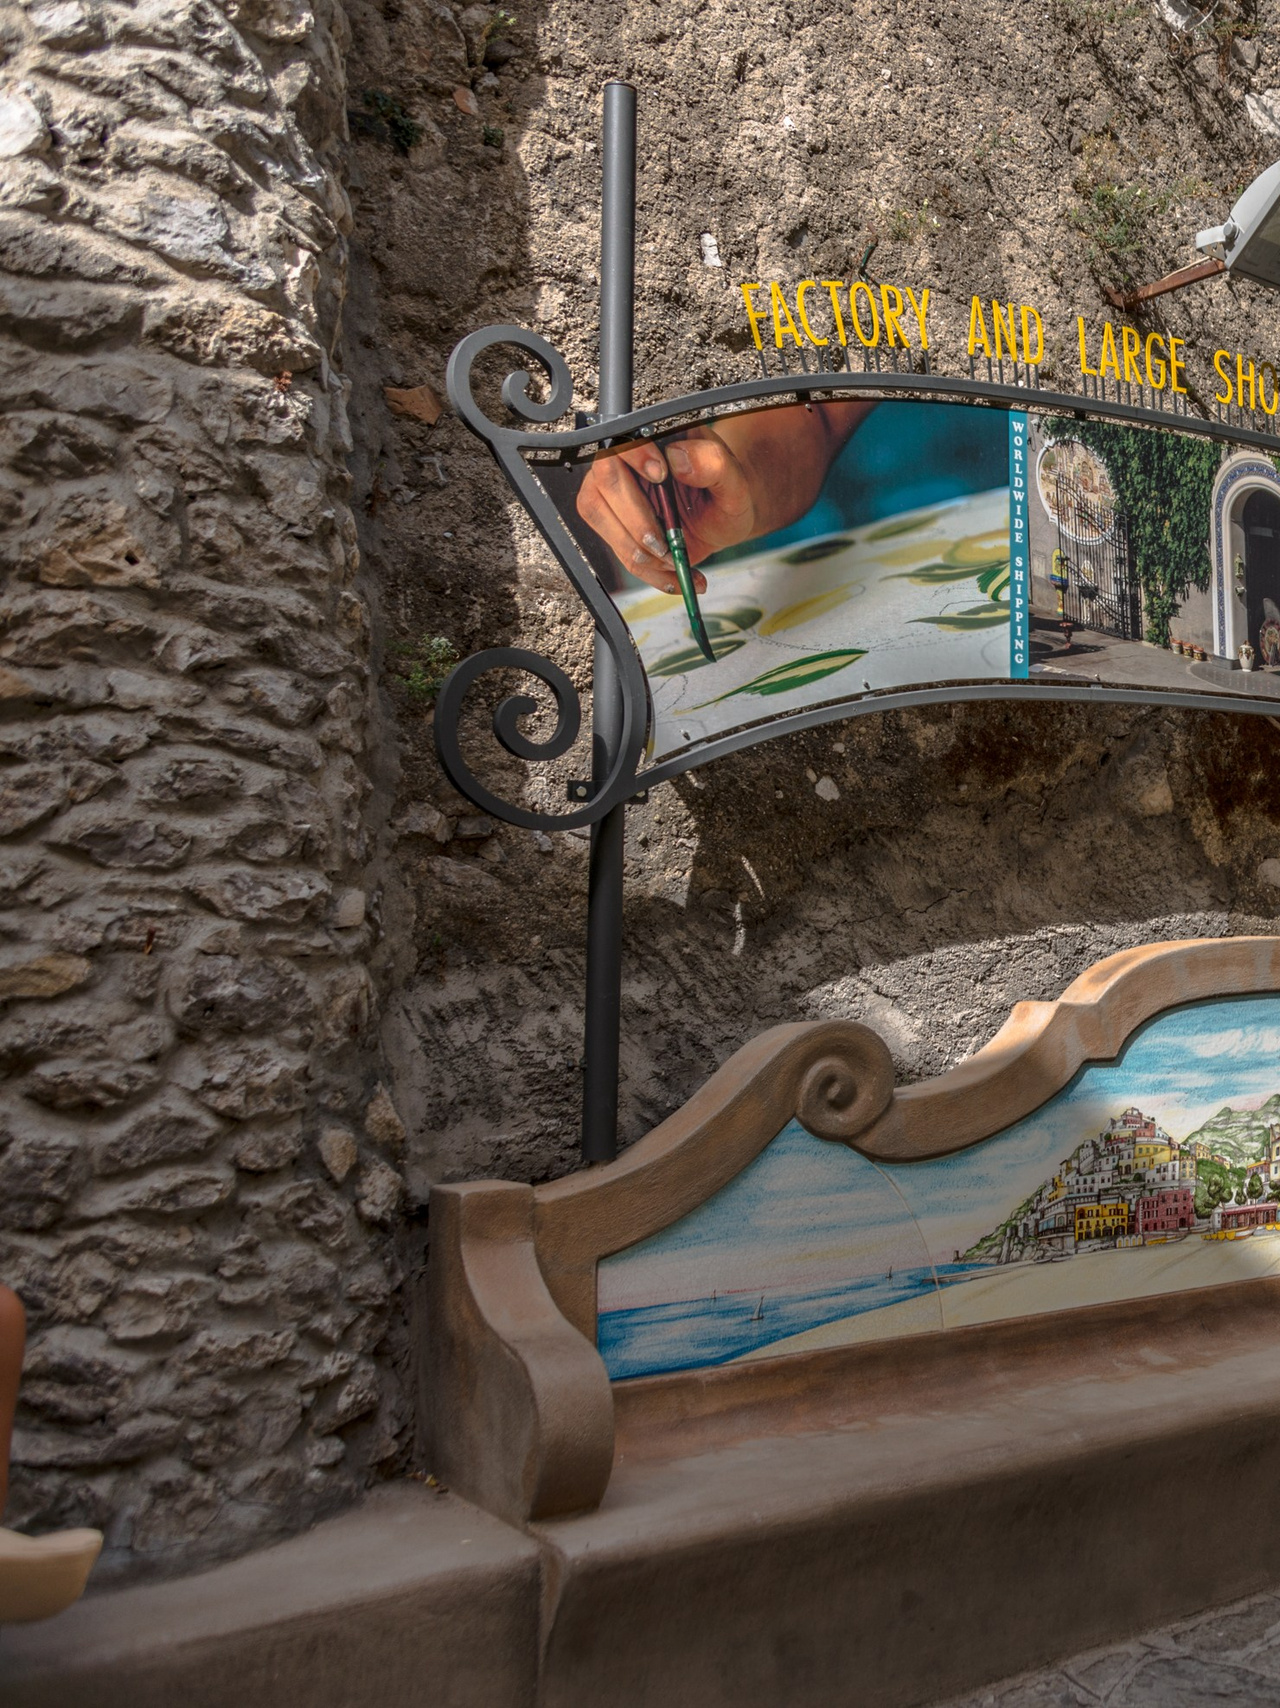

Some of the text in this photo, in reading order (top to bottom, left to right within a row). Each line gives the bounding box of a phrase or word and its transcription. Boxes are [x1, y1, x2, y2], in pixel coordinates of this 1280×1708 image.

[741, 280, 930, 351] FACTORY
[967, 295, 1045, 365] AND
[1077, 315, 1188, 395] LARGE
[1012, 421, 1025, 664] WORLDWIDE SHIPPING
